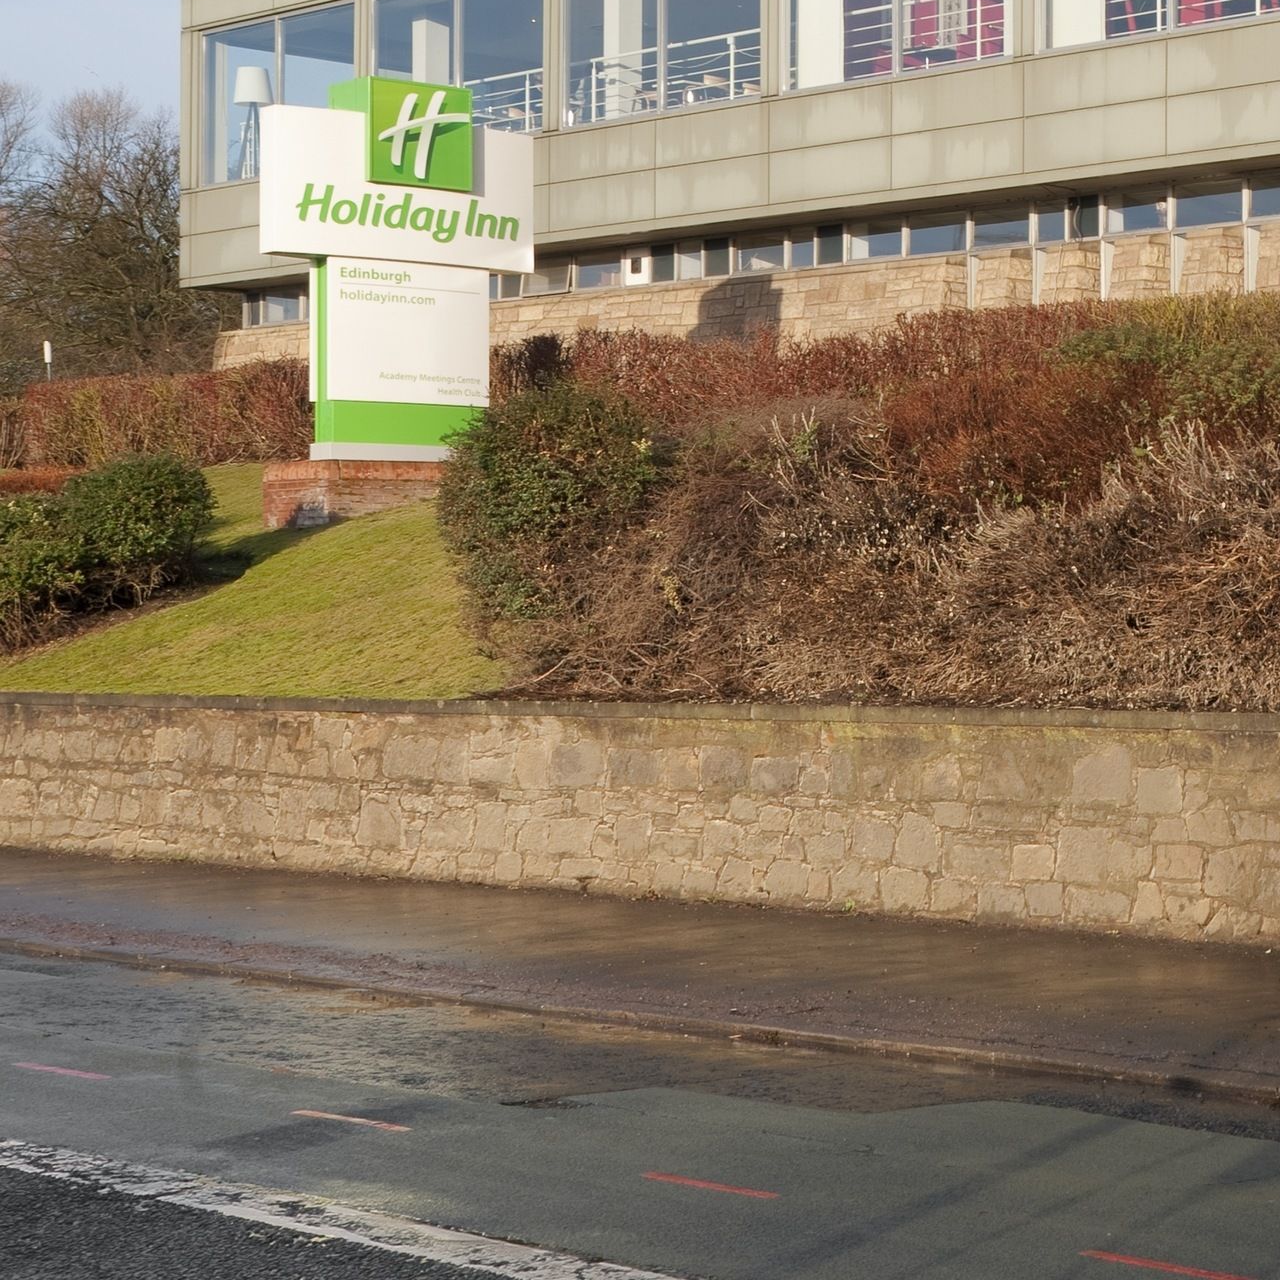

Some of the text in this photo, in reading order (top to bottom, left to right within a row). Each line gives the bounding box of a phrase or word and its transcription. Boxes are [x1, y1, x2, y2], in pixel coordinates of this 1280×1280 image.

[296, 183, 520, 243] Holiday Inn
[340, 267, 411, 284] Edinburgh
[340, 289, 436, 306] holidayinn.com
[379, 372, 481, 385] Academy Meetings Centre
[438, 387, 463, 397] Health
